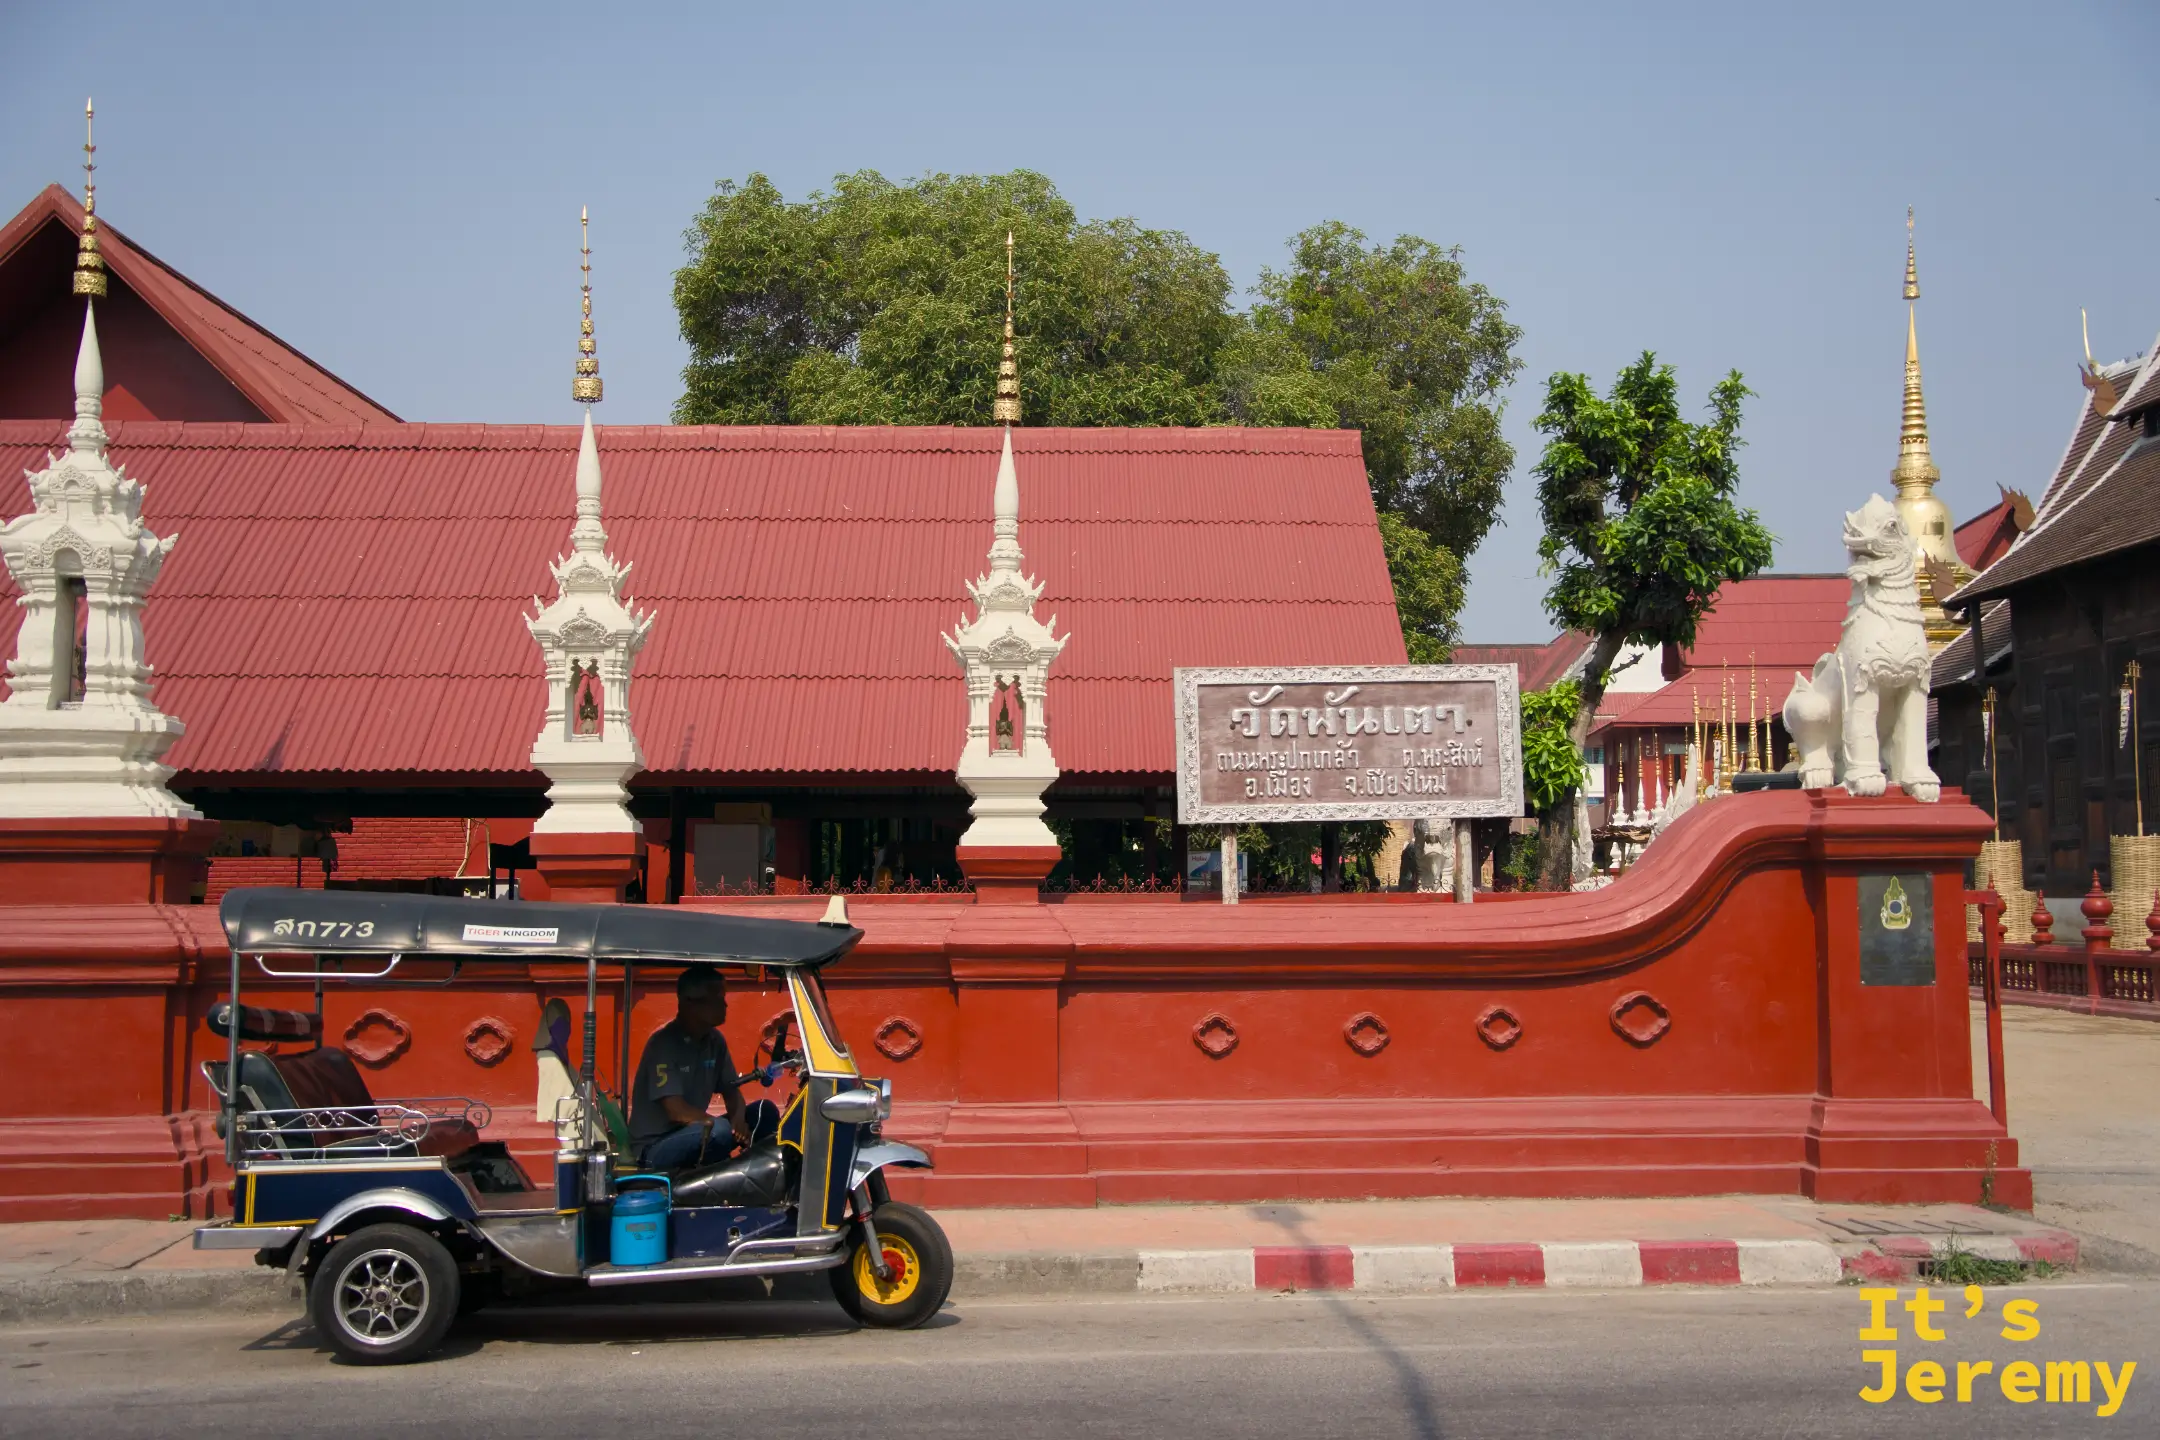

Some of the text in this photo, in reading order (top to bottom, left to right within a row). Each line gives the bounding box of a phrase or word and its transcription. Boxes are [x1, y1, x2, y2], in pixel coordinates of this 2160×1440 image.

[1231, 684, 1465, 738] วัดพันเตา
[1216, 739, 1360, 771] ถนนพระปกเกล้า
[1245, 767, 1448, 798] อ.เมือง จ.เชียงใหม่
[467, 928, 500, 936] TIGER
[656, 1063, 668, 1089] 5
